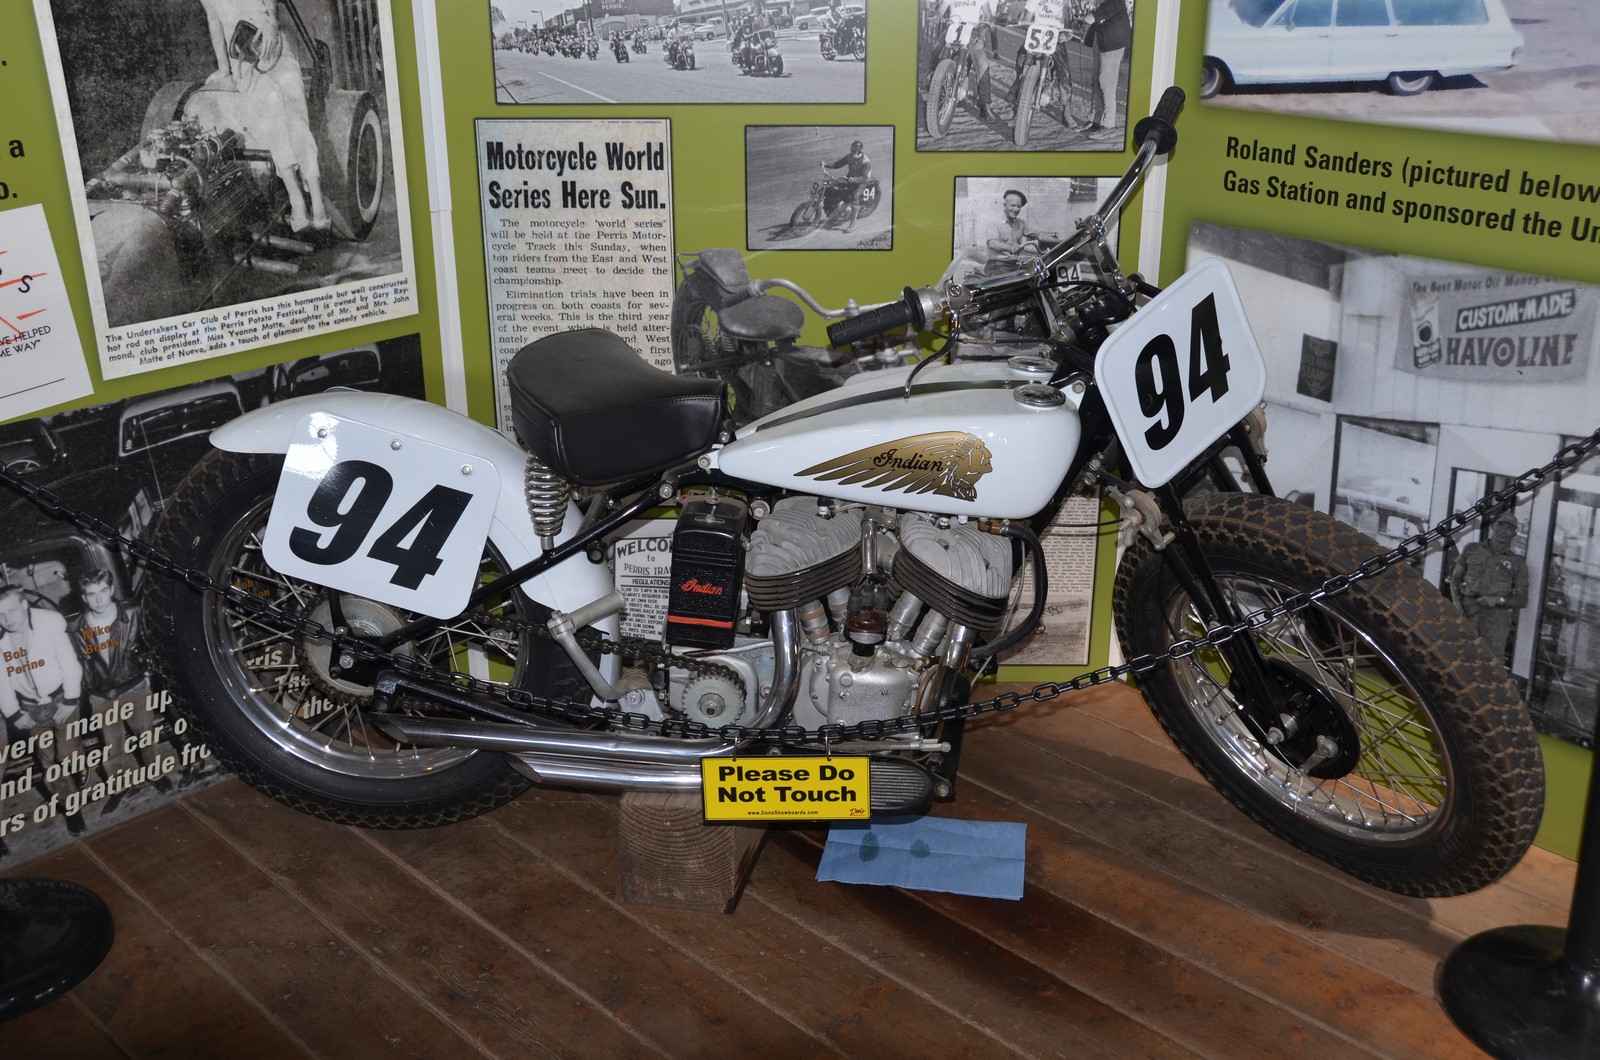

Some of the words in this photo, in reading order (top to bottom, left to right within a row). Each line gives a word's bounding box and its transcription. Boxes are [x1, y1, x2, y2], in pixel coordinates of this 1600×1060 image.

[1028, 28, 1055, 51] 52
[8, 139, 25, 158] a
[486, 141, 597, 177] Motorcycle
[605, 142, 664, 171] World
[1226, 136, 1296, 166] Roland
[1304, 146, 1393, 178] Sanders
[1402, 156, 1511, 193] (pictured
[1519, 171, 1600, 204] below
[488, 180, 551, 209] Series
[561, 181, 611, 209] Here
[621, 181, 666, 209] Sun.
[863, 186, 876, 201] 94
[1223, 170, 1260, 195] Gas
[1266, 175, 1339, 207] Station
[1346, 191, 1387, 214] and
[1392, 199, 1516, 232] sponsored
[1522, 212, 1563, 239] the
[500, 219, 520, 228] The
[530, 219, 585, 229] motorcycle
[490, 230, 509, 239] will
[514, 231, 526, 239] be
[531, 231, 553, 239] held
[575, 231, 590, 240] the
[597, 231, 628, 240] Perris
[632, 231, 667, 240] Motor-
[492, 242, 517, 252] cycle
[526, 242, 556, 251] Track
[565, 242, 583, 251] this
[591, 242, 631, 253] Sunday,
[640, 243, 667, 252] when
[493, 254, 508, 264] top
[512, 254, 541, 262] riders
[544, 254, 568, 262] from
[572, 254, 588, 263] the
[591, 254, 613, 263] East
[619, 254, 637, 263] and
[642, 254, 667, 263] West
[493, 265, 517, 274] coast
[526, 266, 556, 274] teams
[563, 266, 588, 274] meet
[596, 266, 606, 274] to
[613, 265, 644, 275] decide
[652, 266, 668, 275] the
[1058, 265, 1080, 281] 94
[493, 277, 564, 287] championship.
[1413, 282, 1427, 293] The
[1430, 281, 1450, 292] Best
[1454, 279, 1482, 291] Motor
[1486, 277, 1499, 289] Oil
[506, 290, 564, 299] Elimination
[570, 290, 597, 299] trials
[603, 290, 626, 299] have
[631, 290, 654, 298] been
[106, 335, 122, 343] The
[127, 325, 178, 339] Undertakers
[201, 316, 218, 325] Club
[235, 308, 258, 318] Perris
[262, 305, 274, 313] has
[278, 301, 291, 310] this
[295, 294, 333, 306] homemade
[336, 290, 348, 298] but
[351, 287, 365, 295] well
[369, 278, 408, 291] constructed
[496, 303, 538, 312] progress
[561, 301, 583, 310] both
[590, 302, 621, 310] coasts
[627, 301, 643, 310] for
[649, 302, 670, 310] sev-
[1458, 291, 1573, 330] CUSTOM-MADE
[107, 344, 121, 352] hot
[126, 340, 140, 348] rod
[160, 332, 188, 343] display
[204, 326, 217, 334] the
[221, 320, 245, 331] Perris
[248, 314, 273, 325] Potato
[277, 307, 307, 319] Festival.
[334, 297, 356, 307] owned
[360, 295, 368, 304] by
[372, 291, 389, 301] Gary
[394, 287, 409, 296] Ray-
[496, 313, 516, 322] eral
[521, 313, 553, 321] weeks.
[558, 312, 585, 321] This
[598, 312, 614, 321] the
[618, 312, 643, 321] third
[648, 313, 670, 323] year
[14, 325, 51, 342] HELPED
[109, 351, 135, 362] mond,
[140, 346, 158, 356] club
[163, 338, 202, 353] president.
[207, 334, 224, 342] Miss
[229, 327, 258, 338] Yvonne
[290, 314, 322, 326] daughter
[327, 310, 334, 318] of
[339, 307, 352, 315] Mr.
[356, 303, 369, 311] and
[373, 299, 389, 308] Mrs.
[393, 295, 410, 304] John
[512, 324, 528, 332] the
[616, 324, 638, 332] held
[642, 324, 670, 332] alter-
[140, 355, 163, 365] Motte
[167, 352, 175, 360] of
[179, 347, 206, 358] Nuevo,
[209, 341, 227, 351] adds
[238, 334, 259, 345] touch
[262, 332, 270, 340] of
[274, 326, 304, 339] glamour
[318, 320, 330, 328] the
[333, 312, 357, 325] speedy
[361, 309, 387, 319] vehicle.
[499, 335, 529, 344] nately
[645, 335, 671, 343] West
[650, 346, 671, 354] first
[1445, 334, 1578, 367] HAVOLINE
[1135, 291, 1231, 451] 94
[873, 448, 944, 472] Indian
[288, 459, 474, 591] 94
[647, 554, 656, 562] to
[624, 562, 650, 576] PERRIS
[653, 566, 671, 576] TRA
[680, 579, 724, 596] Indian
[81, 625, 111, 640] Mike
[3, 647, 28, 662] Bob
[6, 658, 45, 677] Perine
[65, 700, 135, 740] made
[145, 689, 173, 713] up
[46, 743, 112, 783] other
[124, 724, 164, 754] car
[718, 766, 810, 782] Please
[819, 765, 855, 781] Do
[33, 792, 59, 824] of
[65, 753, 175, 817] gratitude
[718, 786, 766, 803] Not
[774, 786, 856, 802] Touch
